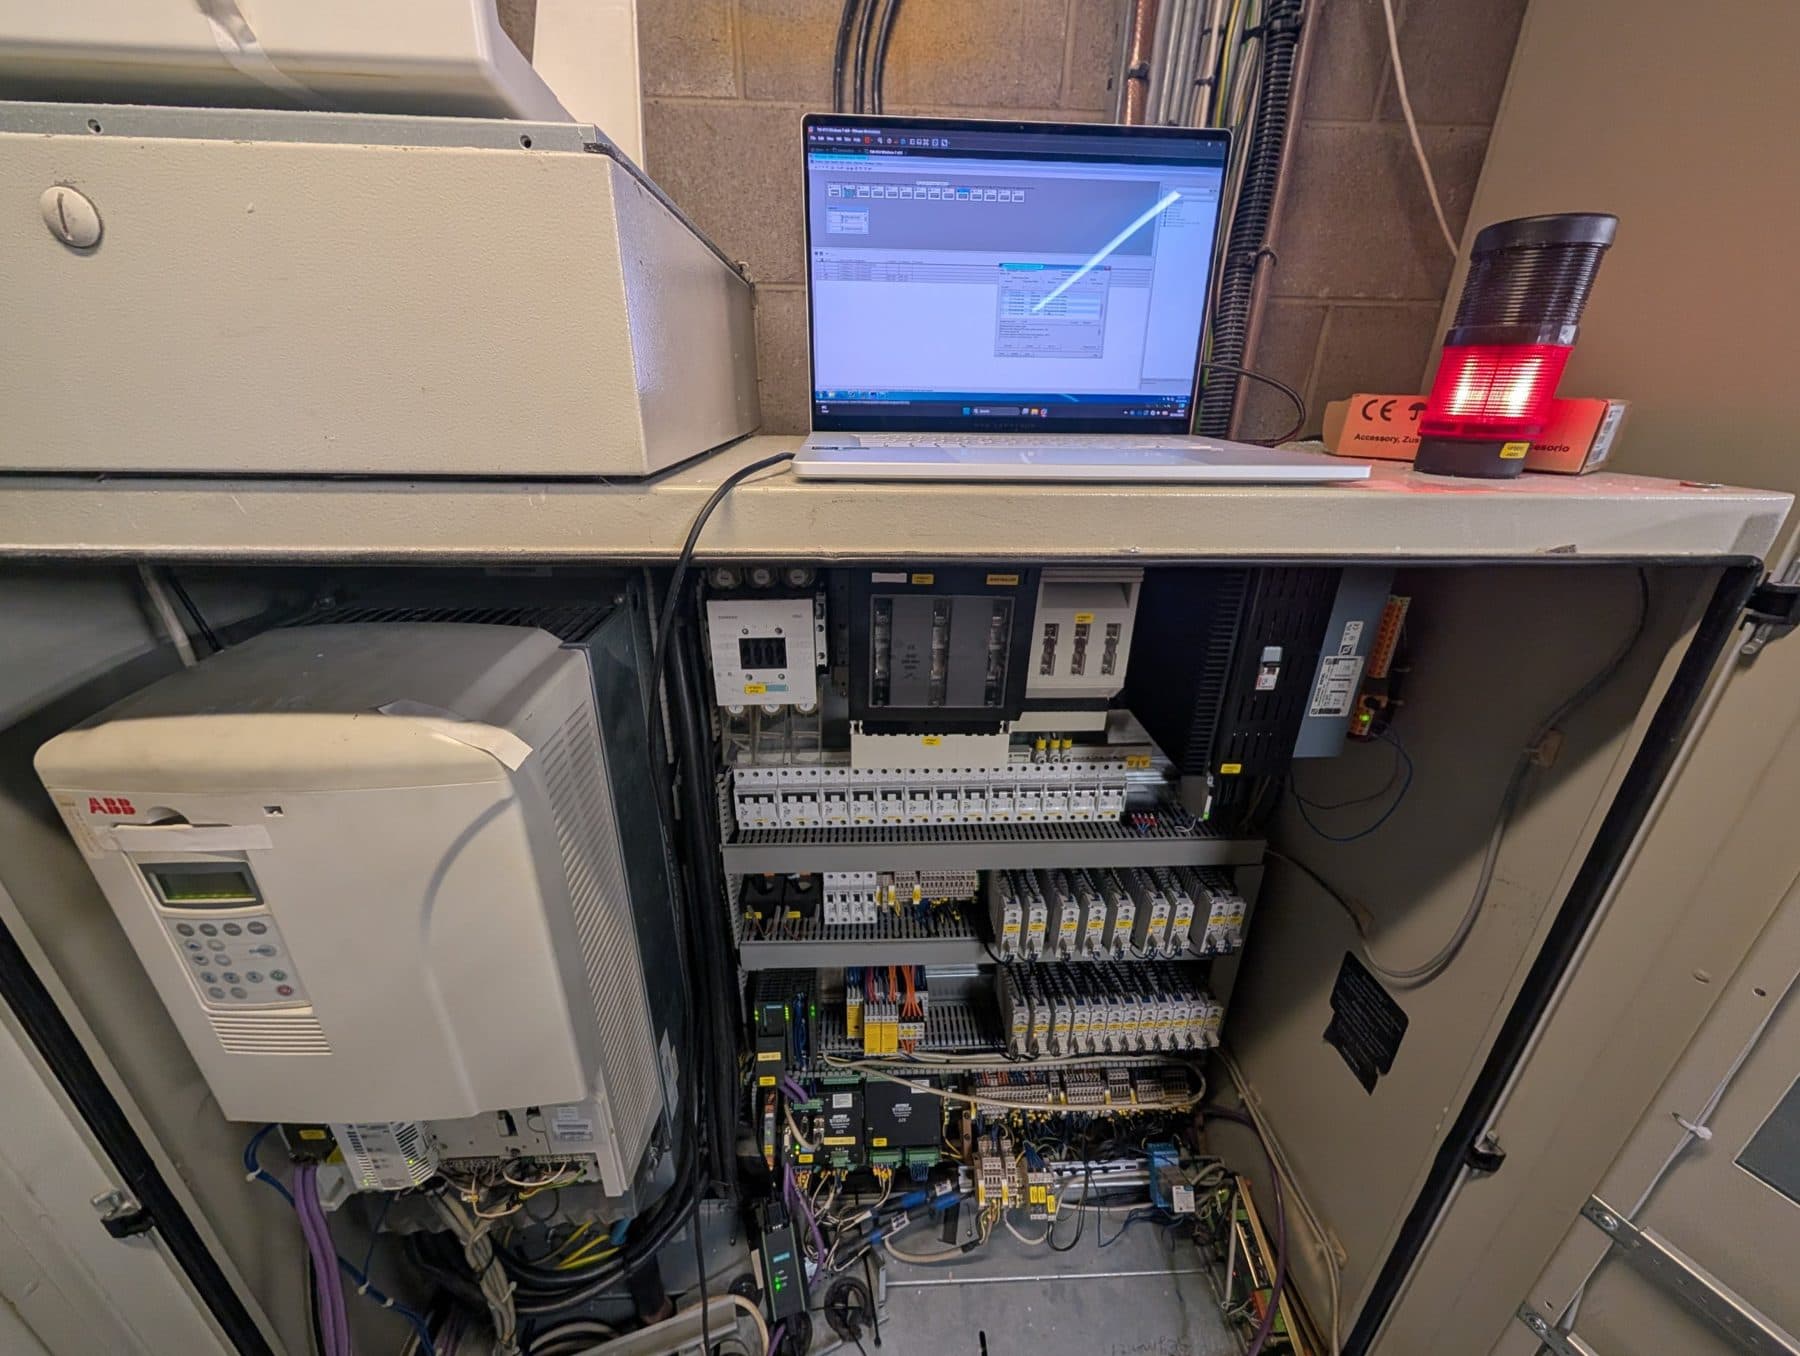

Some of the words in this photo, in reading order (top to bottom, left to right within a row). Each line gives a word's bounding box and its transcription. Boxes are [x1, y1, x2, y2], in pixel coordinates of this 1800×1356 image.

[1354, 433, 1400, 444] Accessory,
[1402, 435, 1420, 444] Zus
[1533, 443, 1570, 453] esorio
[89, 797, 136, 815] ABB
